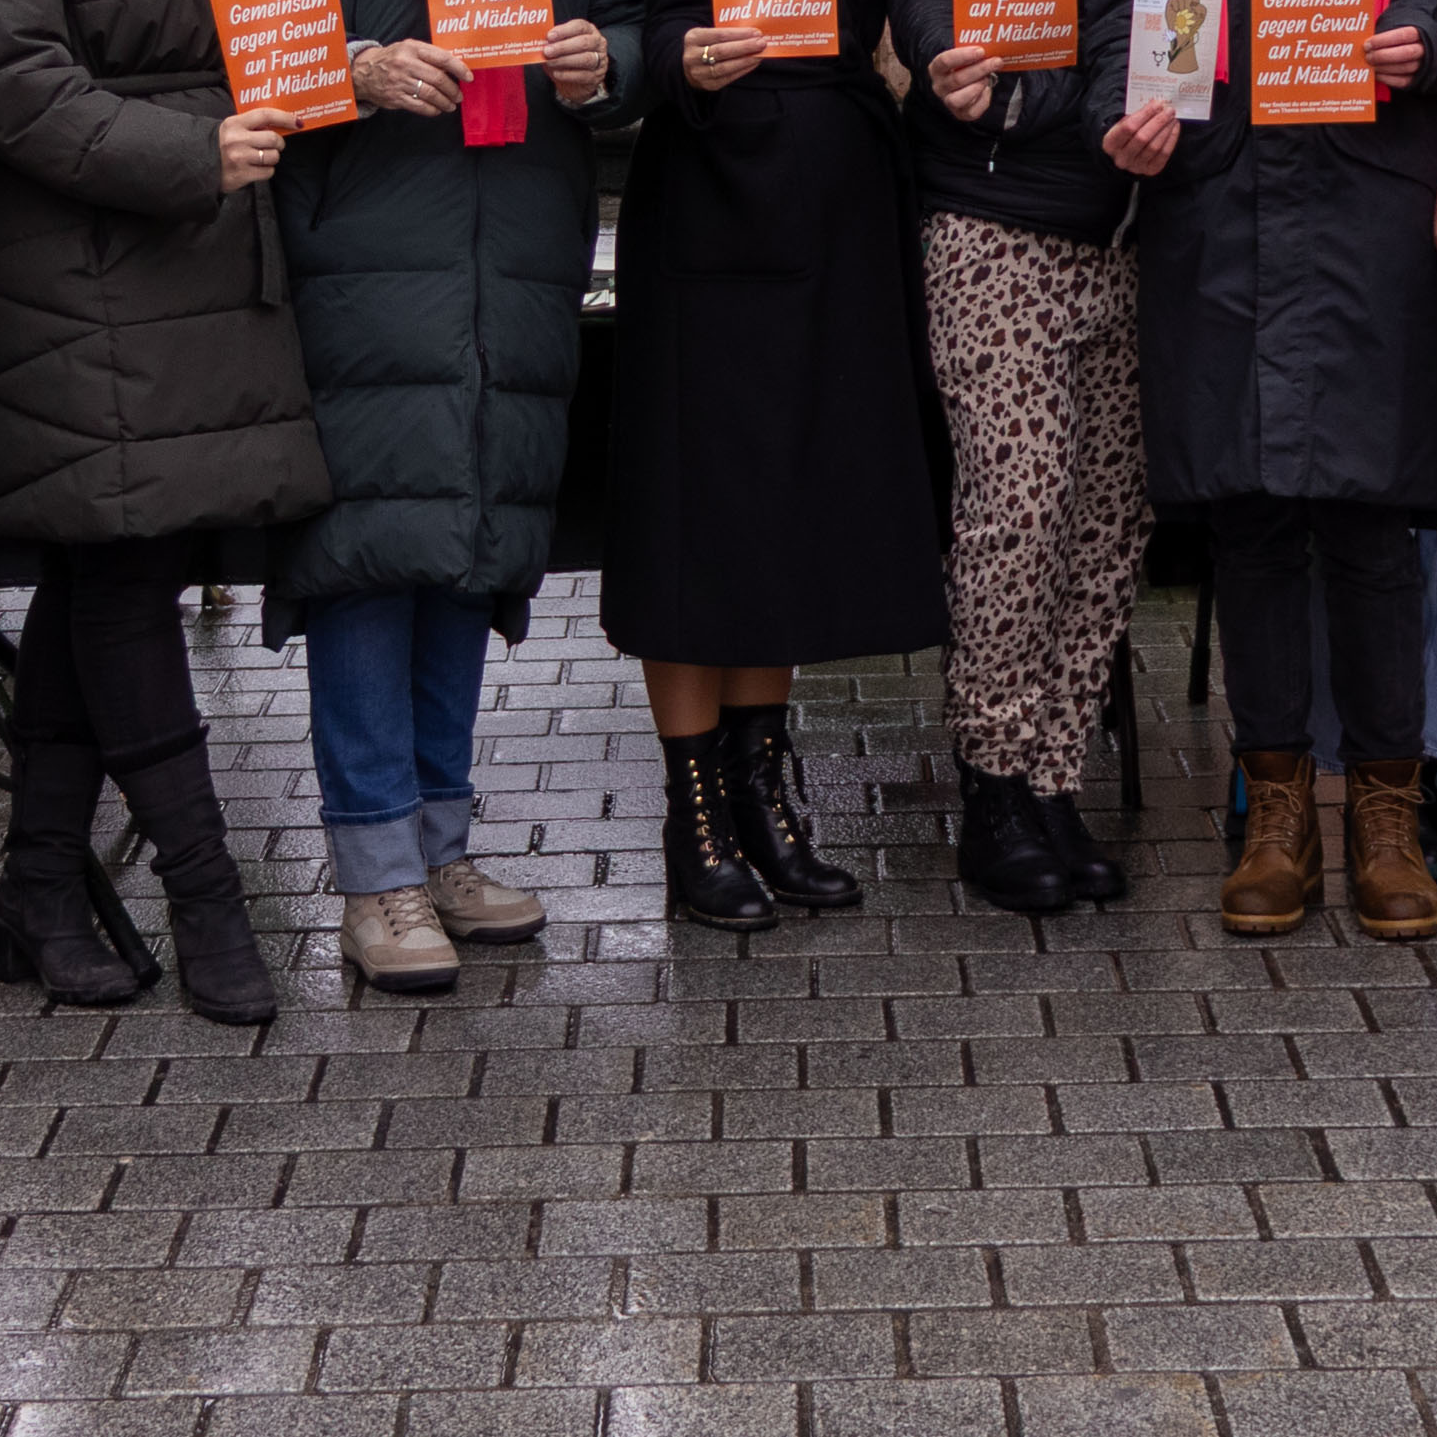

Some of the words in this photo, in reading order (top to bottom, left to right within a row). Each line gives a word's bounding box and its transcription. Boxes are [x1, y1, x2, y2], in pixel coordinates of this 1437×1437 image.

[436, 10, 469, 33] und
[473, 5, 548, 29] Mädchen
[719, 0, 752, 21] und
[968, 3, 991, 17] an
[229, 29, 276, 56] gegen
[281, 11, 337, 41] Gewalt
[959, 23, 993, 42] und
[996, 21, 1072, 41] Mädchen
[1256, 19, 1306, 38] gegen
[1310, 11, 1368, 32] Gewalt
[244, 58, 265, 76] an
[270, 45, 327, 70] Frauen
[1267, 45, 1290, 59] an
[1294, 40, 1352, 58] Frauen
[239, 78, 271, 103] und
[276, 67, 346, 96] Mädchen
[1256, 65, 1292, 85] und
[1294, 63, 1369, 84] Mädchen
